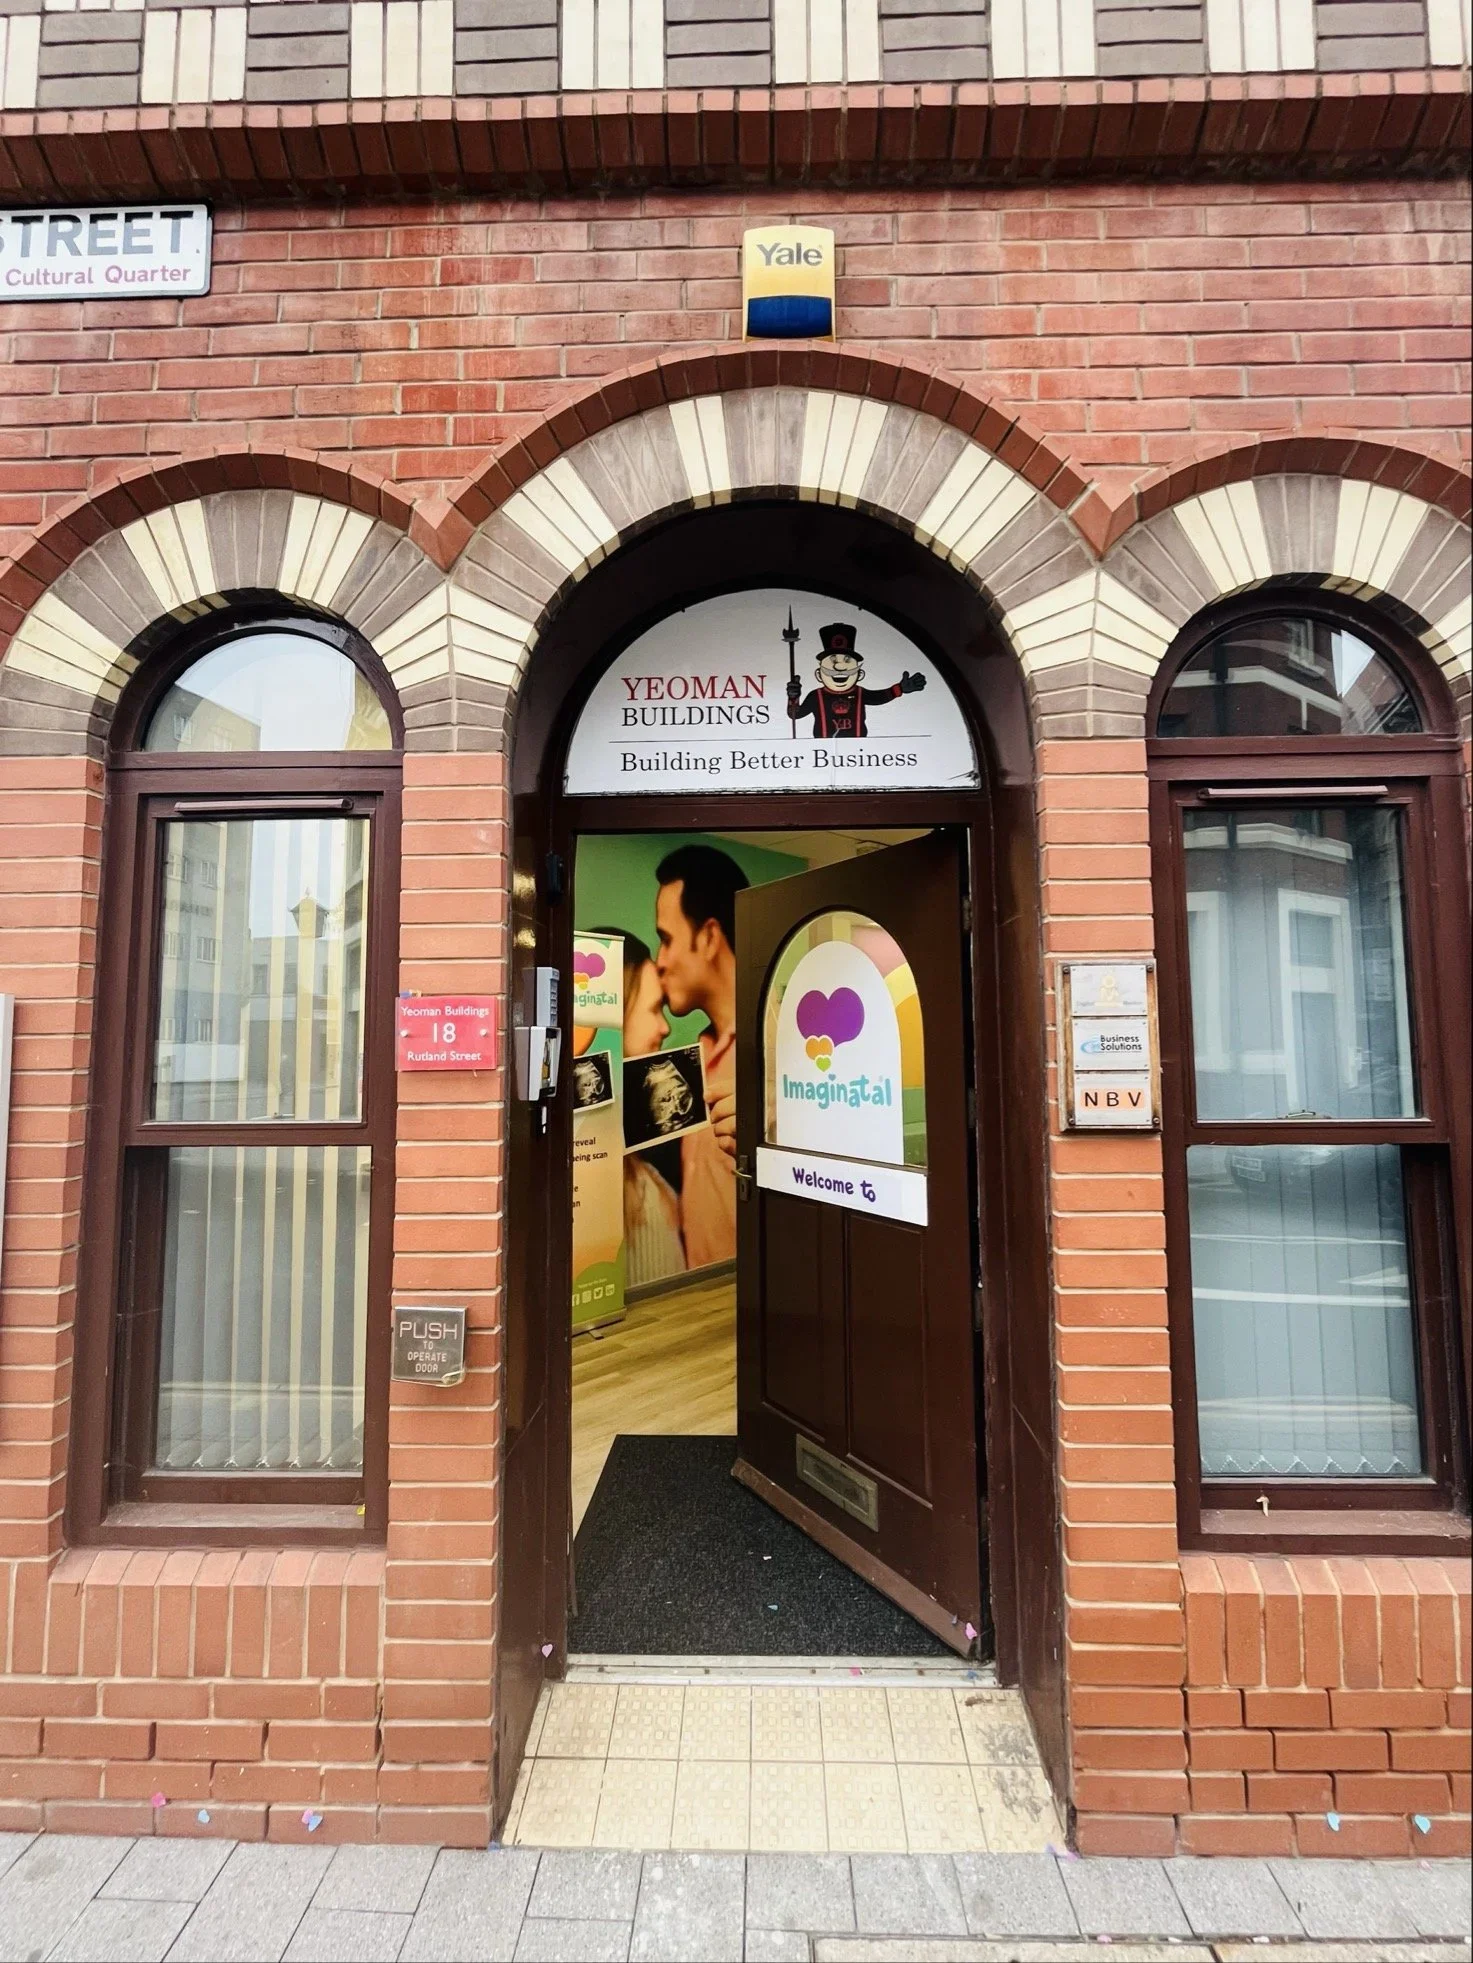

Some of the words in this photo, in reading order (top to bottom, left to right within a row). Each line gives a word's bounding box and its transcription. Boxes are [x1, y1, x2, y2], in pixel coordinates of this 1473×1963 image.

[0, 210, 194, 258] TREET
[756, 242, 823, 267] Yale
[5, 266, 94, 287] Cultural
[104, 264, 192, 284] Quarter
[621, 674, 767, 701] YEOMAN
[621, 704, 770, 727] BUILDINGS
[832, 718, 852, 730] YB
[620, 750, 722, 774] Building
[729, 750, 805, 770] Better
[812, 747, 918, 769] Business
[401, 1006, 441, 1017] Yeoman
[444, 1005, 490, 1018] Buildings
[433, 1022, 456, 1044] 18
[1100, 1034, 1140, 1043] Business
[407, 1051, 447, 1062] Rutland
[450, 1050, 482, 1061] Street
[1100, 1042, 1143, 1051] Solutions
[782, 1073, 892, 1110] Imaginatal
[573, 1153, 591, 1162] eing
[592, 1152, 608, 1160] scan
[792, 1166, 855, 1195] Welcome
[859, 1179, 877, 1203] to
[399, 1321, 458, 1340] PUSH
[422, 1340, 434, 1350] TO
[407, 1351, 448, 1363] OPERATE
[415, 1363, 439, 1373] DOOR
